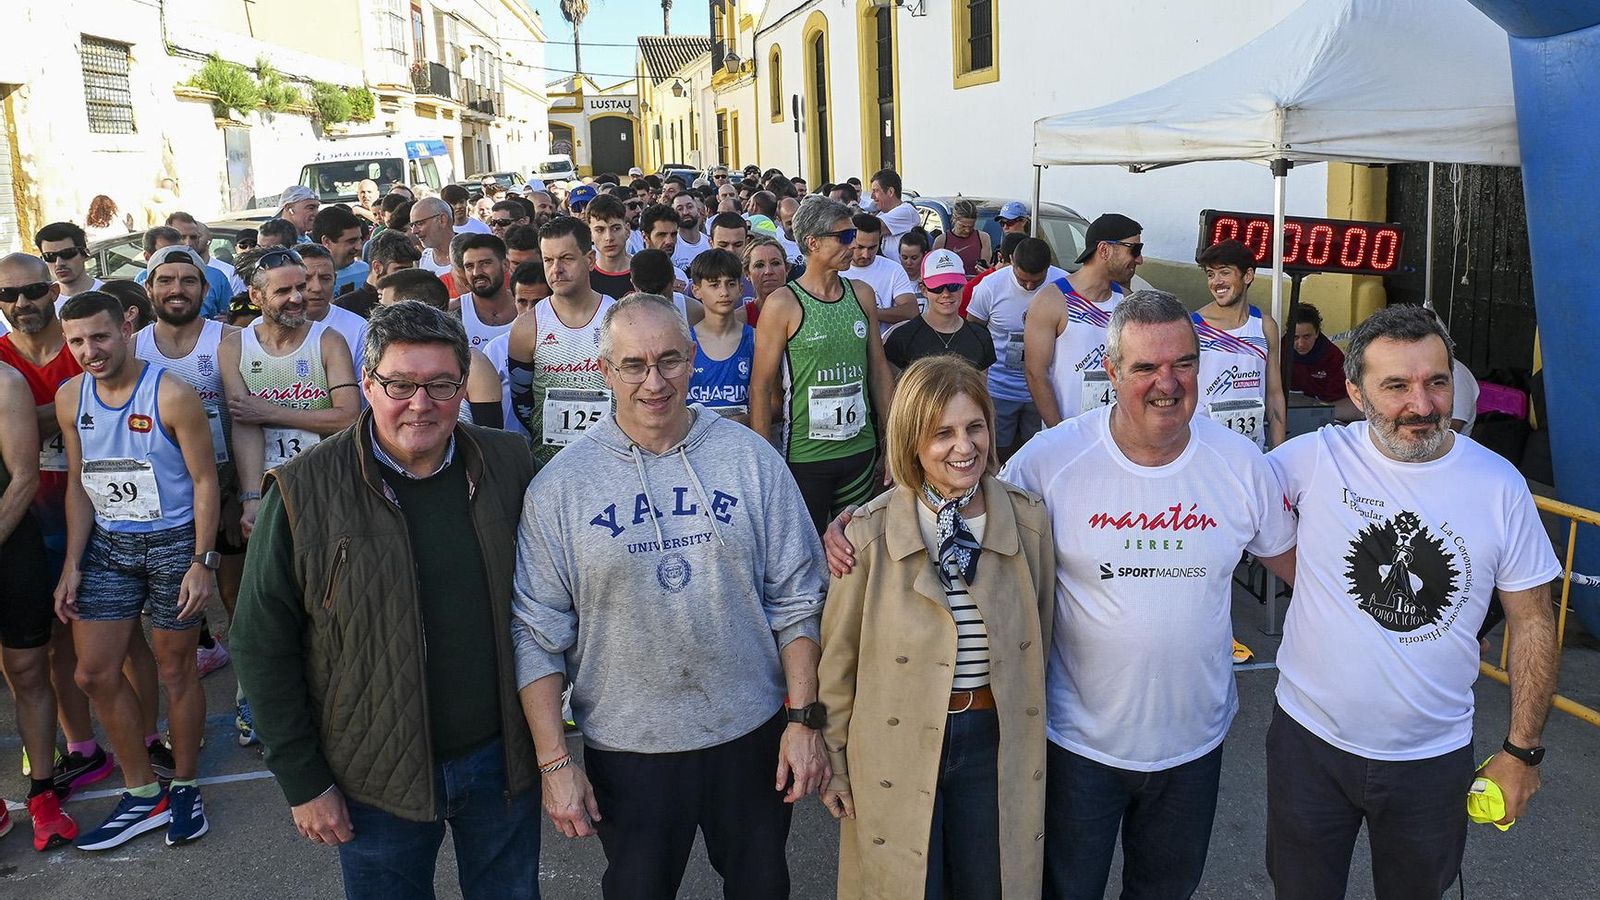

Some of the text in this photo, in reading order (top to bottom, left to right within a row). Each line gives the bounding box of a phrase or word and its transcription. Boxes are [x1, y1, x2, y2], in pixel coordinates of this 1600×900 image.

[591, 100, 631, 108] LUSTAU
[834, 403, 856, 426] 16
[277, 438, 302, 458] 13
[107, 481, 138, 503] 39
[1343, 487, 1349, 504] I
[589, 487, 739, 539] YALE
[1088, 502, 1218, 531] maratón
[1440, 522, 1453, 537] La
[627, 532, 713, 554] UNIVERSITY
[1124, 540, 1183, 550] JEREZ
[1118, 567, 1206, 578] SPORTMADNESS
[1395, 597, 1416, 614] 100
[1399, 629, 1442, 646] Historia
